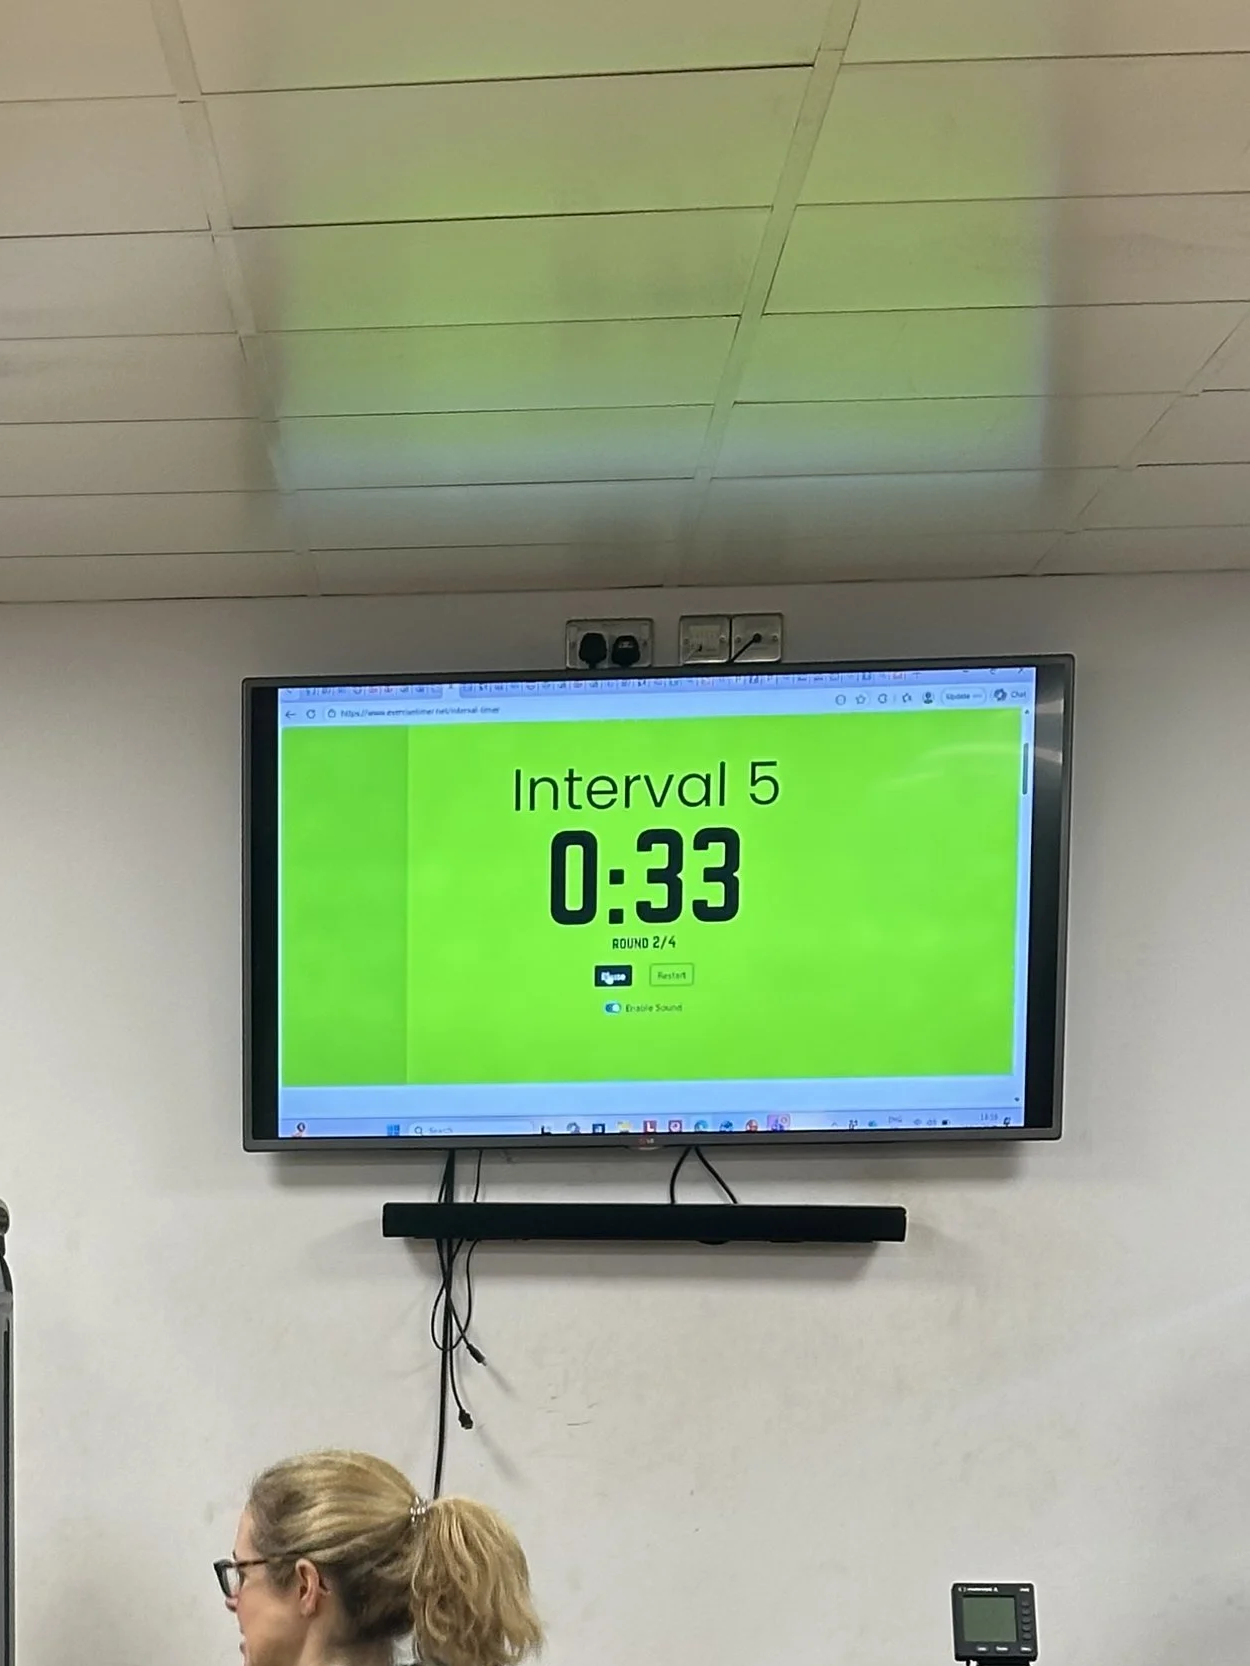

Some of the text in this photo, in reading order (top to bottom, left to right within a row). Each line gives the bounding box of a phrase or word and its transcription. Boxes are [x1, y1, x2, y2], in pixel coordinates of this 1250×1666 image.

[515, 760, 780, 811] Interval 5
[550, 827, 741, 926] 0:33
[611, 935, 677, 950] ROUND 2/4
[657, 971, 687, 980] Restart
[625, 1003, 683, 1013] Enable Sound
